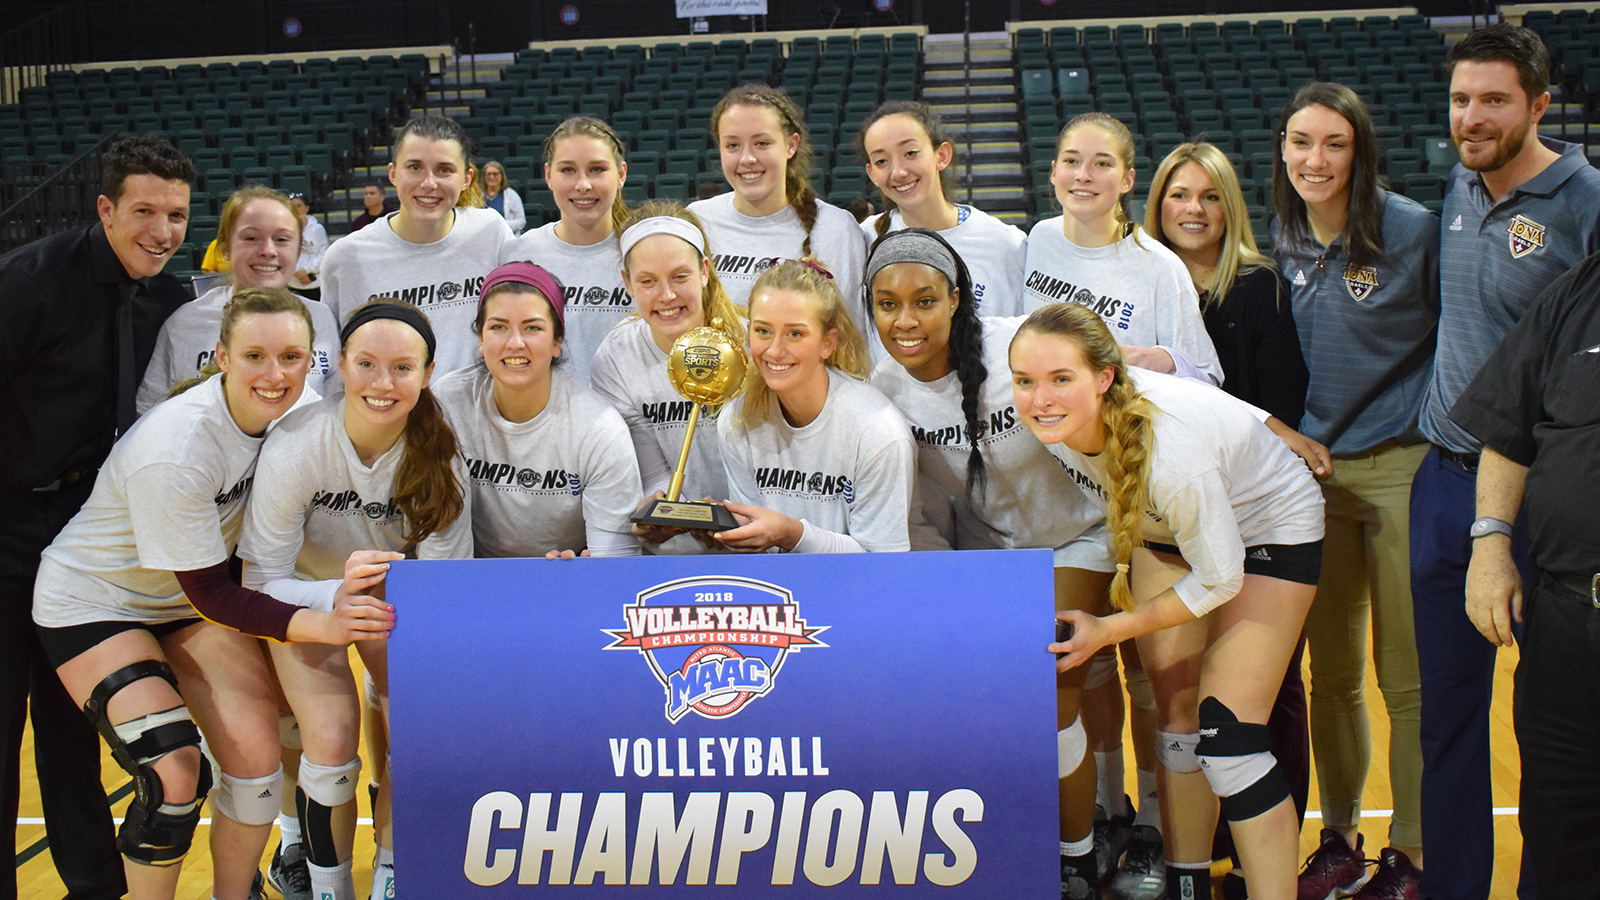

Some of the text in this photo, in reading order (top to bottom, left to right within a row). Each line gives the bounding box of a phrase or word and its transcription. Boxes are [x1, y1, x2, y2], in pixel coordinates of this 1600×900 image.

[1508, 219, 1544, 247] IONA
[1343, 270, 1379, 286] IONA
[1117, 302, 1135, 331] 2018
[684, 357, 719, 367] SPORTS
[695, 592, 734, 602] 2018
[627, 605, 804, 638] VOLLEYBALL
[652, 632, 778, 646] CHAMPIONSHIP
[690, 646, 736, 663] METRO ATLANTIC
[670, 658, 765, 714] MAAC
[695, 691, 747, 713] ATHLETIC CONFERENCE
[609, 736, 829, 777] VOLLEYBALL
[464, 789, 985, 886] CHAMPIONS
